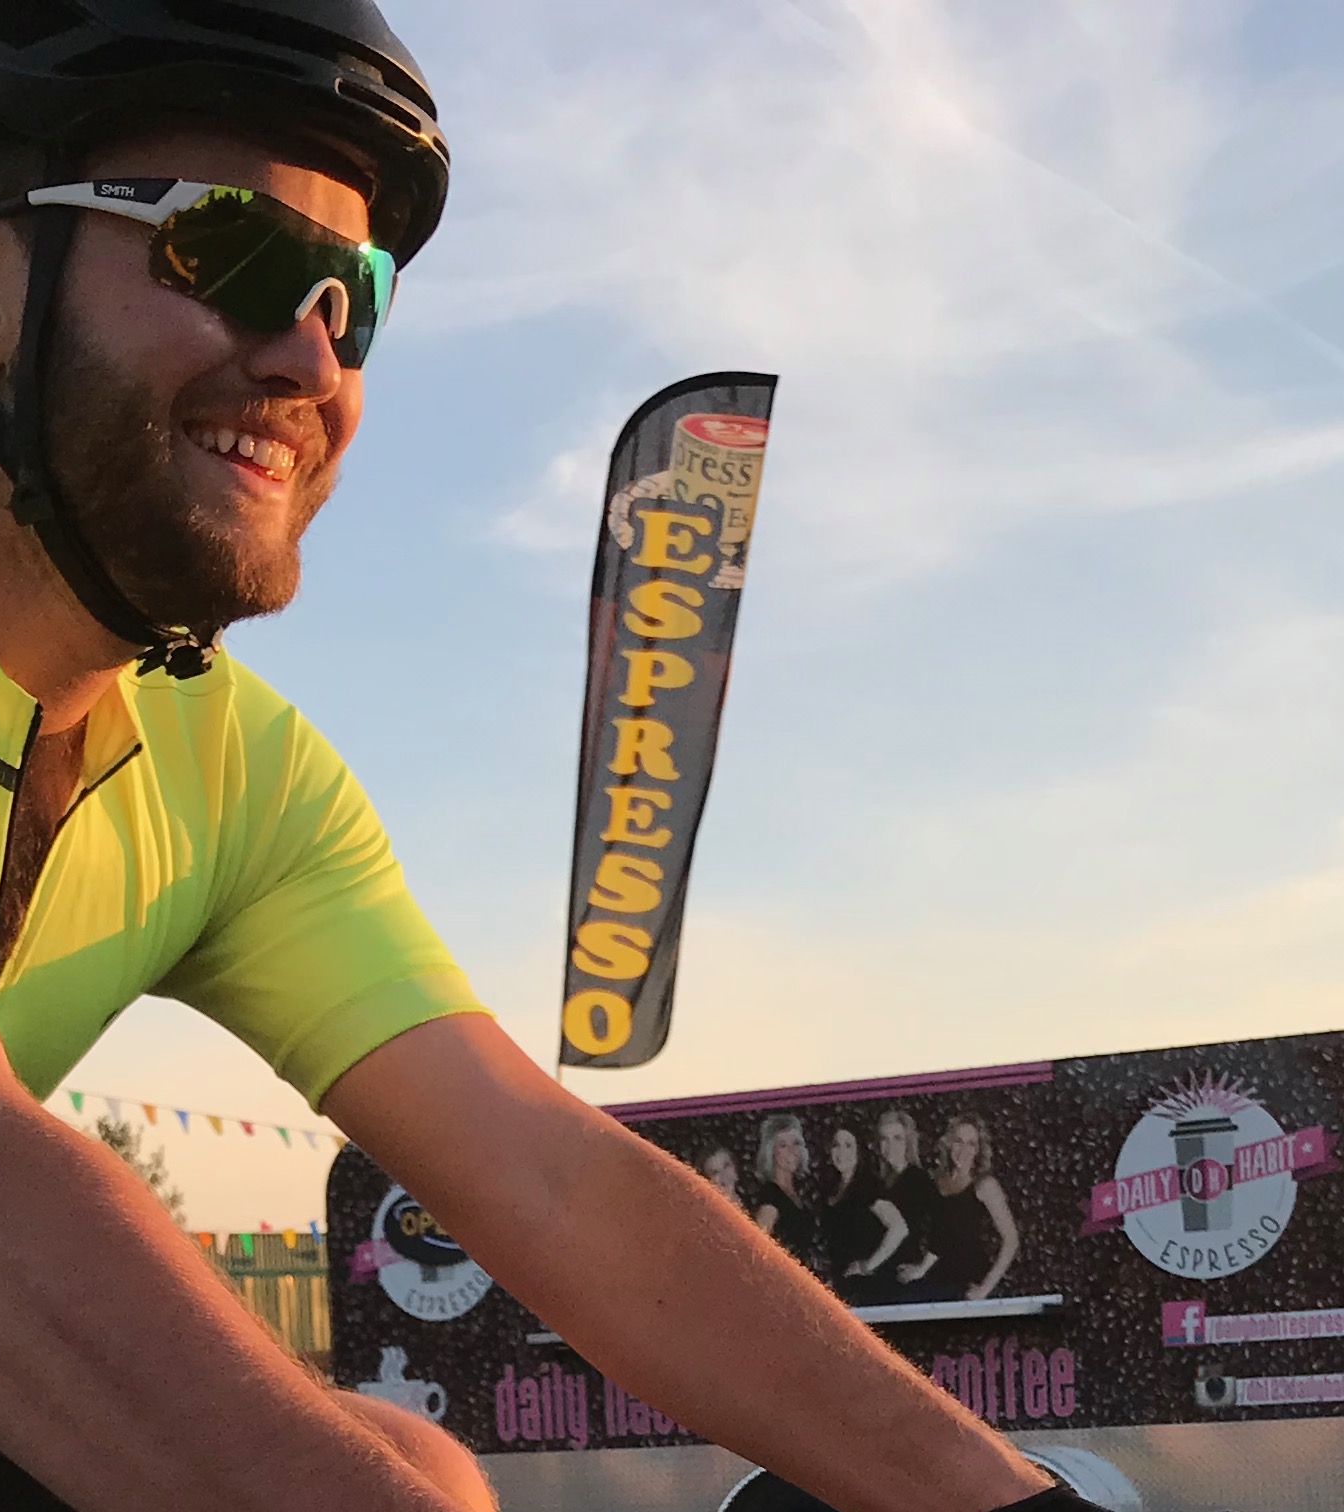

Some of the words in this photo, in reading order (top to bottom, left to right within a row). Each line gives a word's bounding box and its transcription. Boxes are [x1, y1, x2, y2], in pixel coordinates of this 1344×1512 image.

[100, 184, 135, 197] SMITH
[562, 508, 714, 1056] ESPRESSO
[1116, 1168, 1174, 1213] DAILY
[1238, 1135, 1298, 1181] HABIT
[1159, 1215, 1281, 1272] ESPRESSO
[495, 1362, 588, 1449] daily
